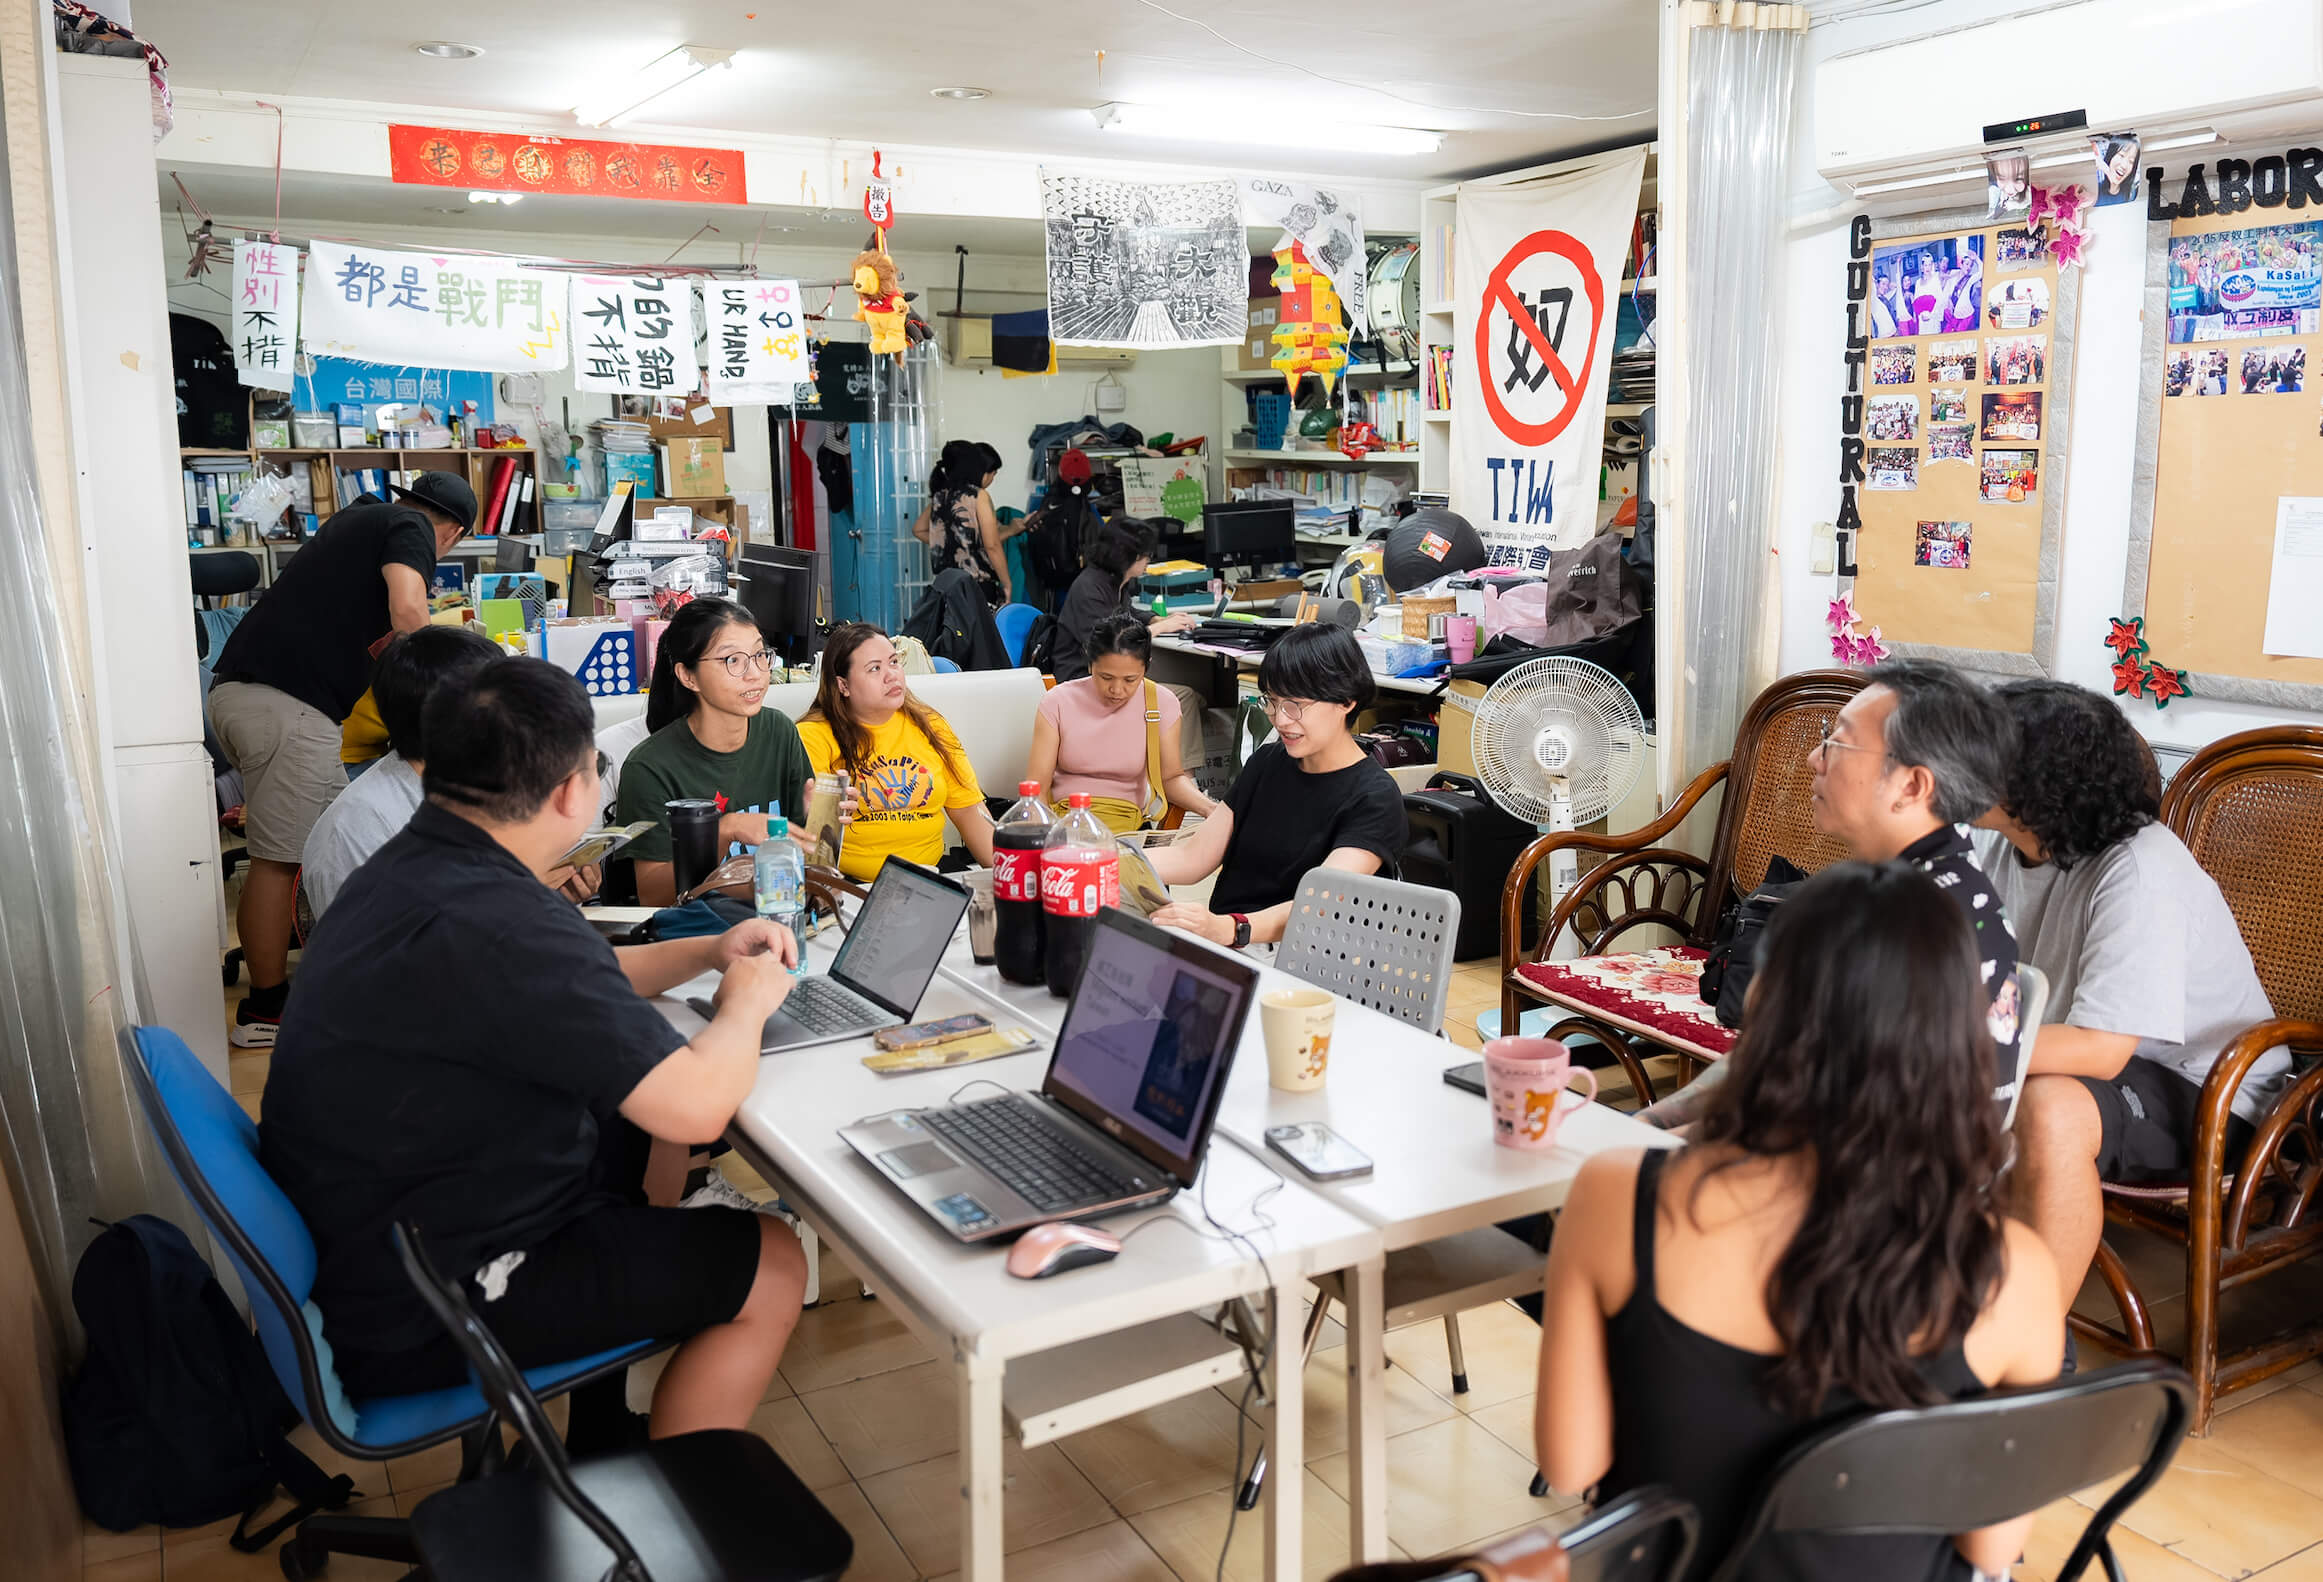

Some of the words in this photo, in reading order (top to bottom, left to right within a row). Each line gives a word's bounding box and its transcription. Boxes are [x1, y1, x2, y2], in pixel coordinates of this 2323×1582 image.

[1251, 179, 1294, 198] GAZA
[2145, 147, 2323, 222] LABOR
[2266, 270, 2313, 281] KaSai
[334, 254, 543, 332] 都是戰鬥
[722, 288, 747, 316] UR
[1352, 271, 1364, 314] FREE
[1503, 286, 1574, 394] 奴
[344, 376, 443, 401] 台灣國際
[1836, 214, 1872, 577] CULTURAL
[618, 567, 647, 577] English
[1041, 866, 1080, 898] Cola
